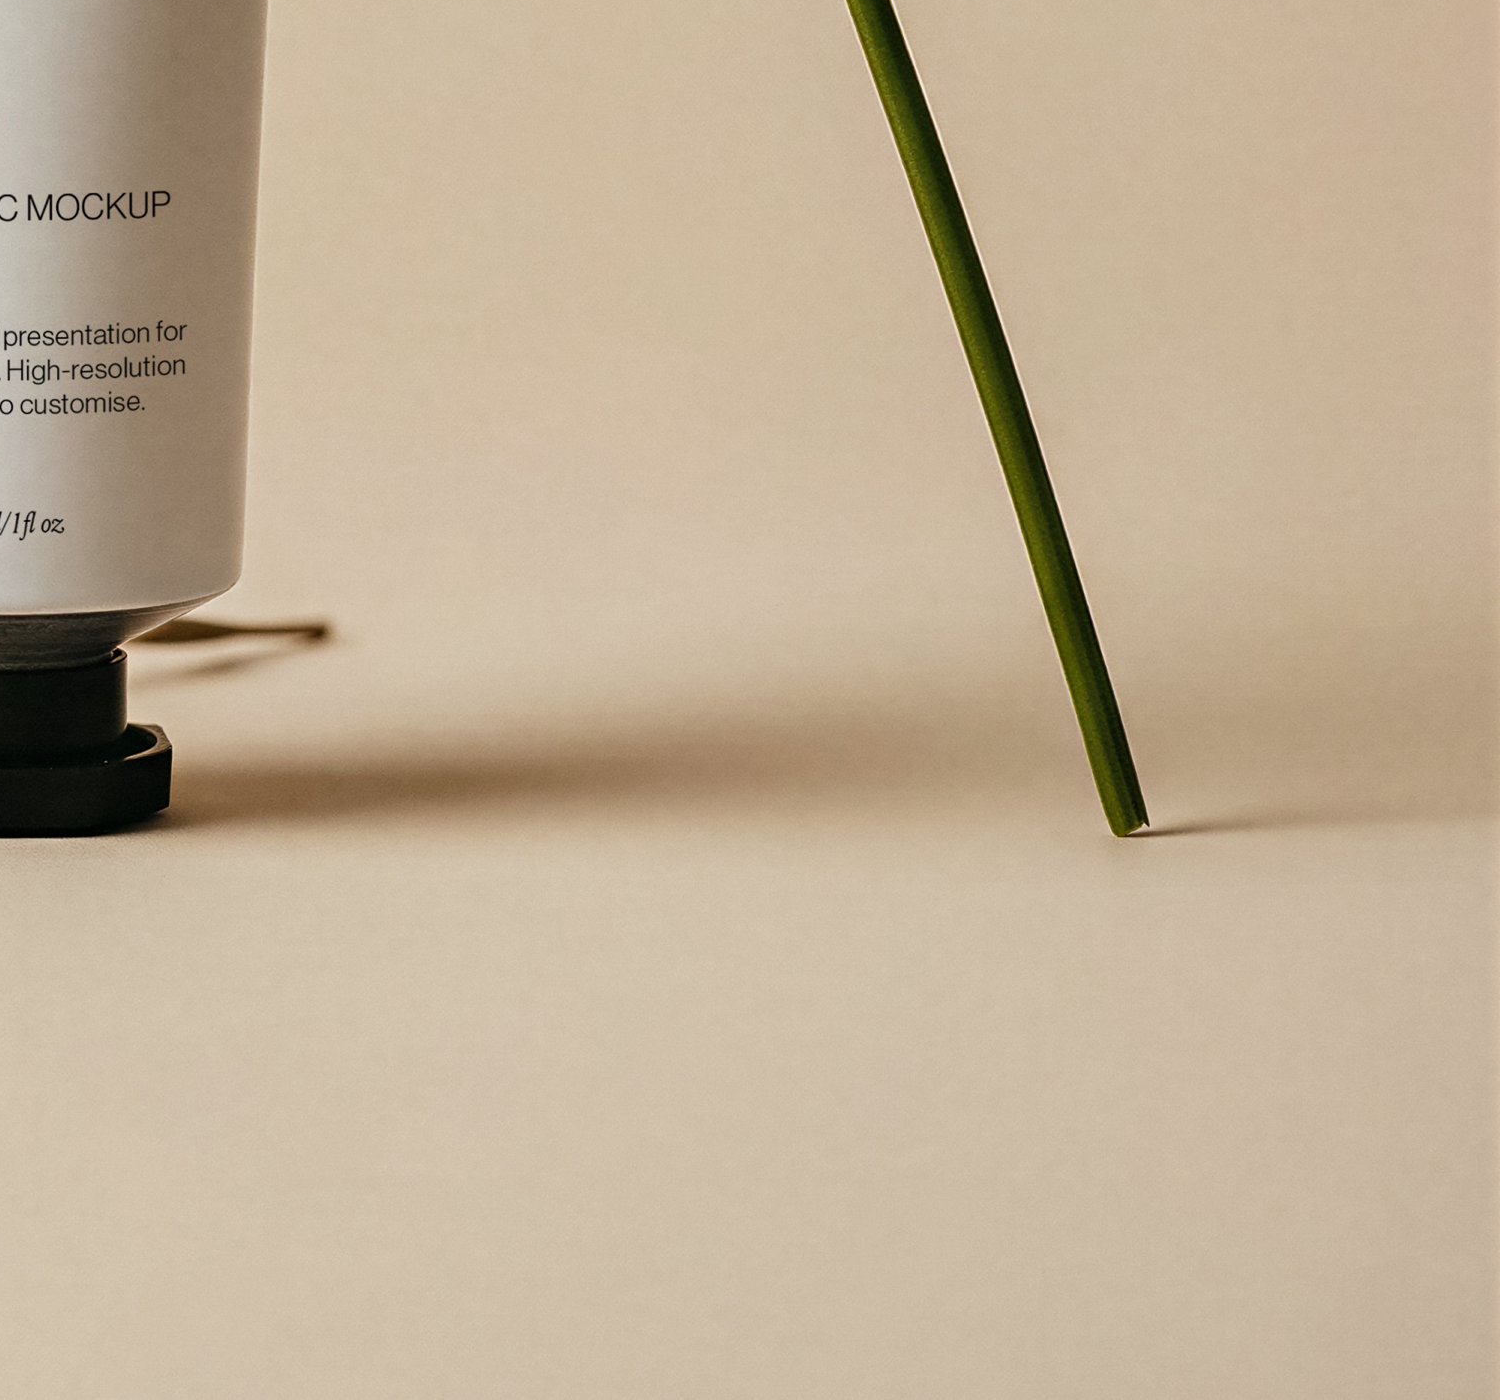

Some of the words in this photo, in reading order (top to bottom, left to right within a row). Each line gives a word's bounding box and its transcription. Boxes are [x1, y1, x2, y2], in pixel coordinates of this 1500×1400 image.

[27, 190, 172, 222] MOCKUP
[3, 322, 150, 351] presentation
[156, 319, 188, 342] for
[7, 354, 186, 385] High-resolution
[19, 390, 146, 415] customise.
[40, 518, 65, 534] oz
